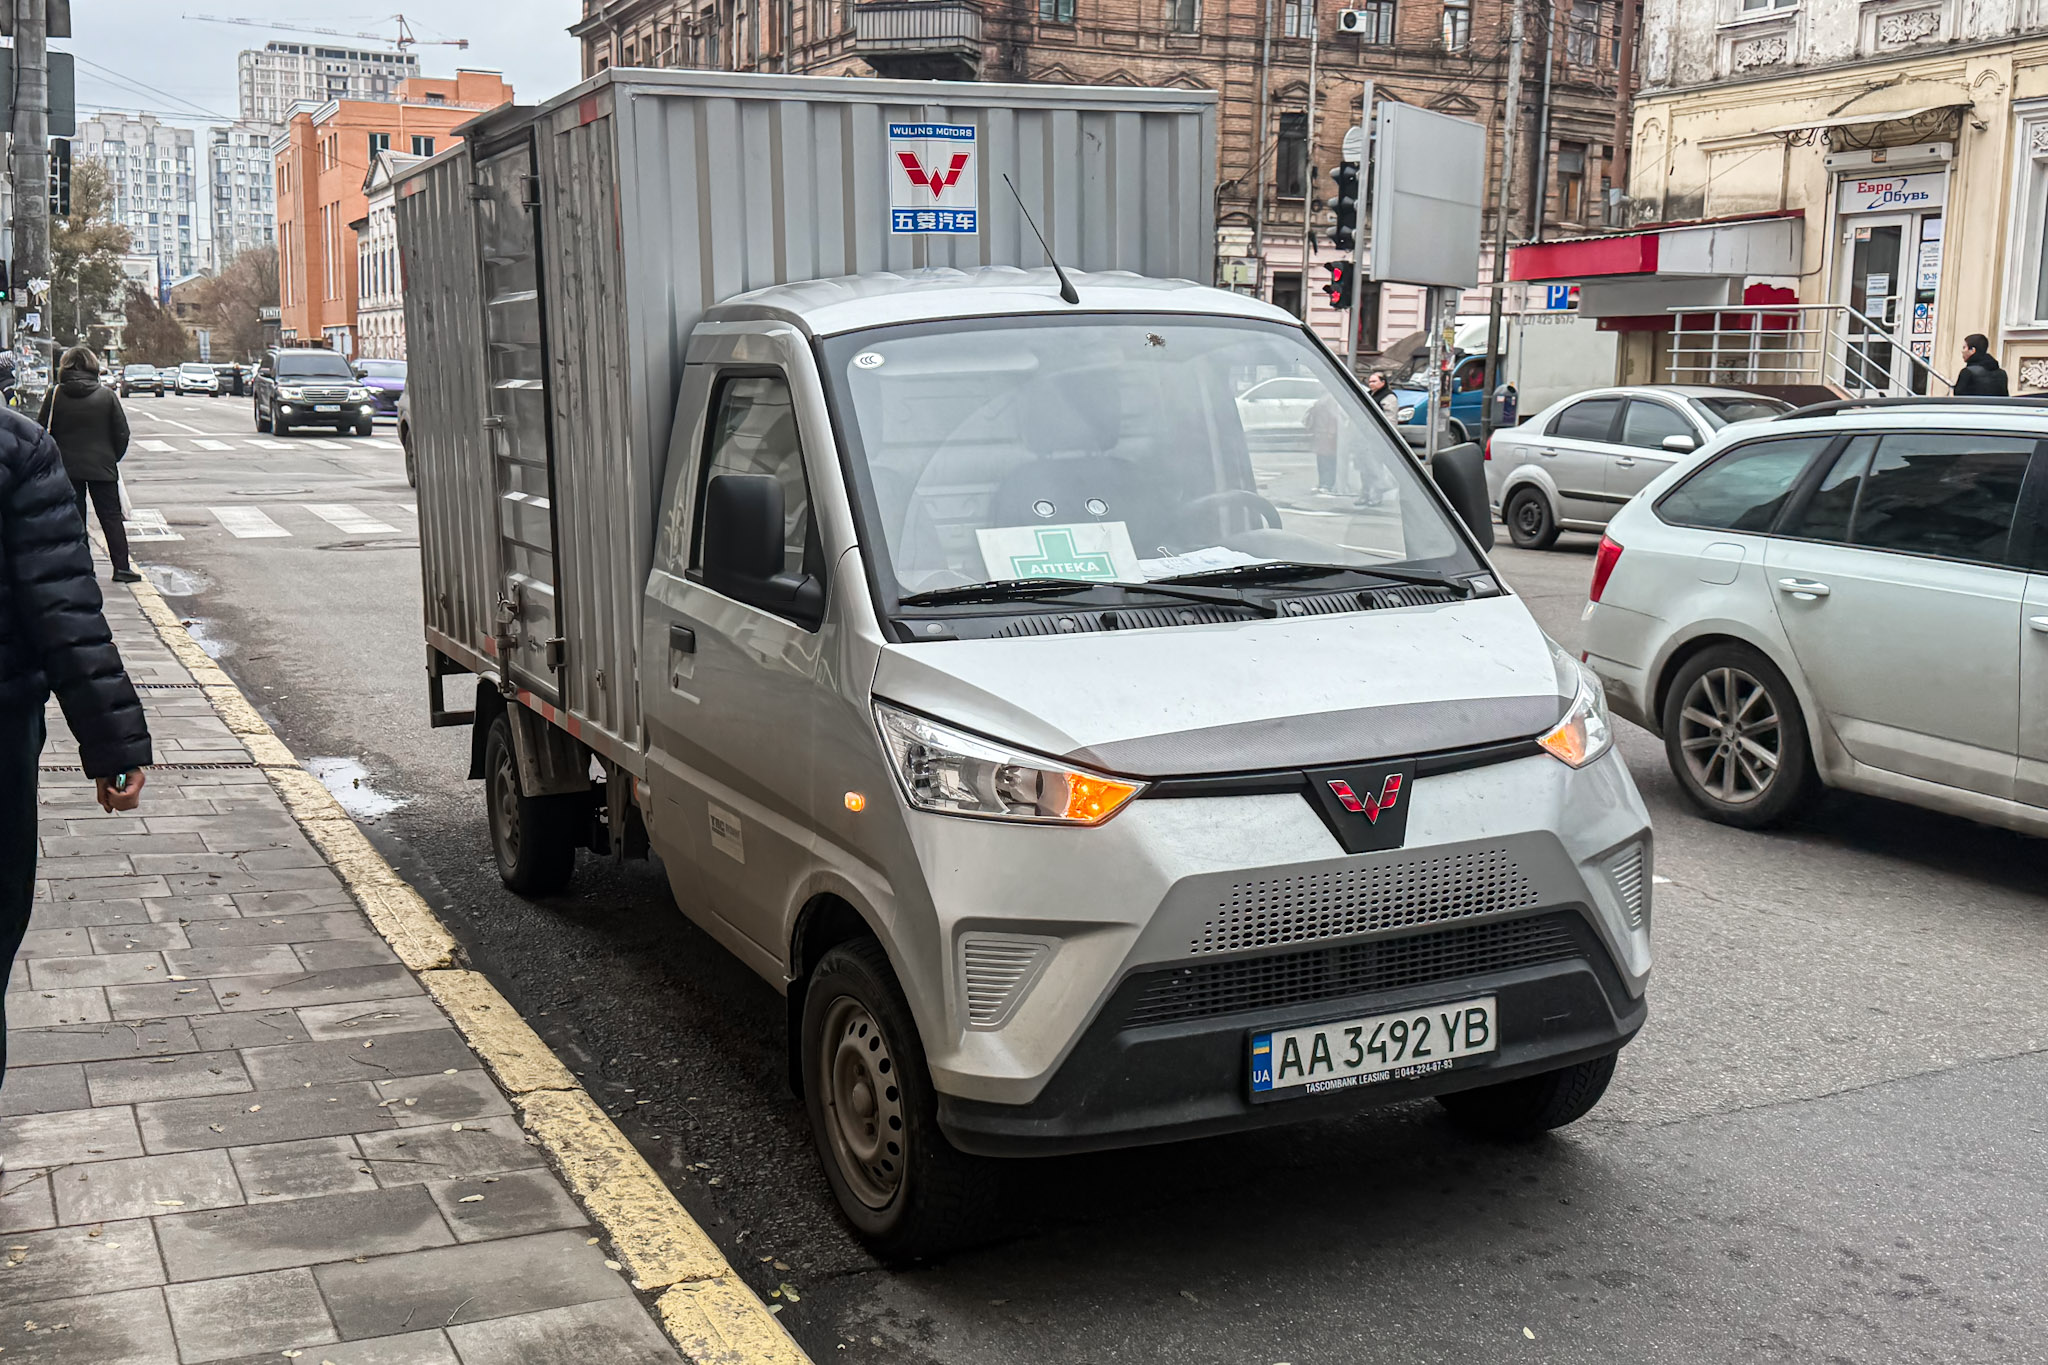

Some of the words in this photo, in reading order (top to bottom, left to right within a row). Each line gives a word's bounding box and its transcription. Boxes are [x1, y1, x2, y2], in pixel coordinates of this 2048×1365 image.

[893, 126, 933, 135] WULING
[936, 127, 972, 137] MOTORS
[1857, 181, 1892, 194] Евро
[1883, 191, 1929, 203] Обувь
[894, 212, 975, 230] 五菱汽车
[1031, 561, 1100, 575] АПТЕКА
[1278, 1032, 1333, 1080] AA
[1343, 1016, 1431, 1068] 3492
[1441, 1007, 1489, 1052] YB
[1253, 1070, 1271, 1083] UA
[1305, 1077, 1357, 1093] TASCOMBANK
[1359, 1070, 1390, 1085] LEASING
